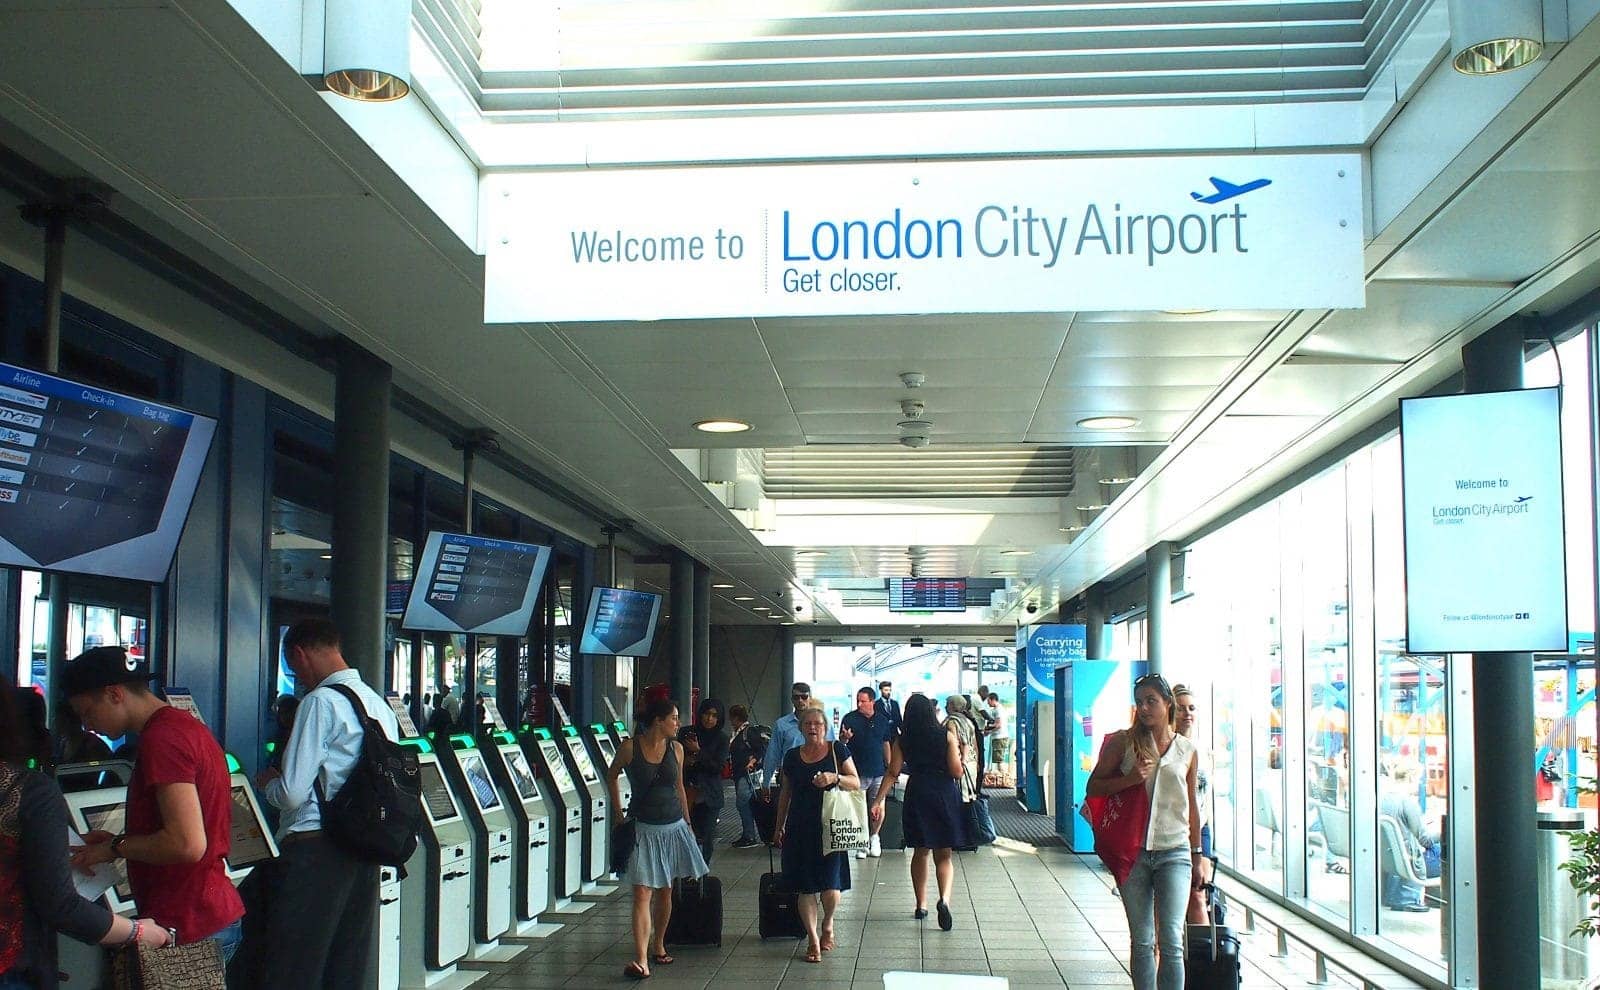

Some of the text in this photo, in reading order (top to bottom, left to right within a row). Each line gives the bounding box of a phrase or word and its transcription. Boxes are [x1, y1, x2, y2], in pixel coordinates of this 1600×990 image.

[783, 203, 1248, 268] London City Airport
[571, 228, 744, 263] Welcome to
[783, 267, 901, 293] Get closer.
[13, 372, 41, 388] Airline
[82, 390, 116, 406] Check-in
[143, 406, 157, 419] Bag
[1455, 478, 1509, 490] Welcome to
[1432, 503, 1528, 518] London City Airport
[1035, 637, 1083, 648] Carrying
[1040, 647, 1067, 656] heavy
[830, 818, 852, 826] Paris
[830, 826, 862, 834] London
[830, 833, 856, 842] Tokyo
[831, 840, 869, 849] Ehrenfeld
